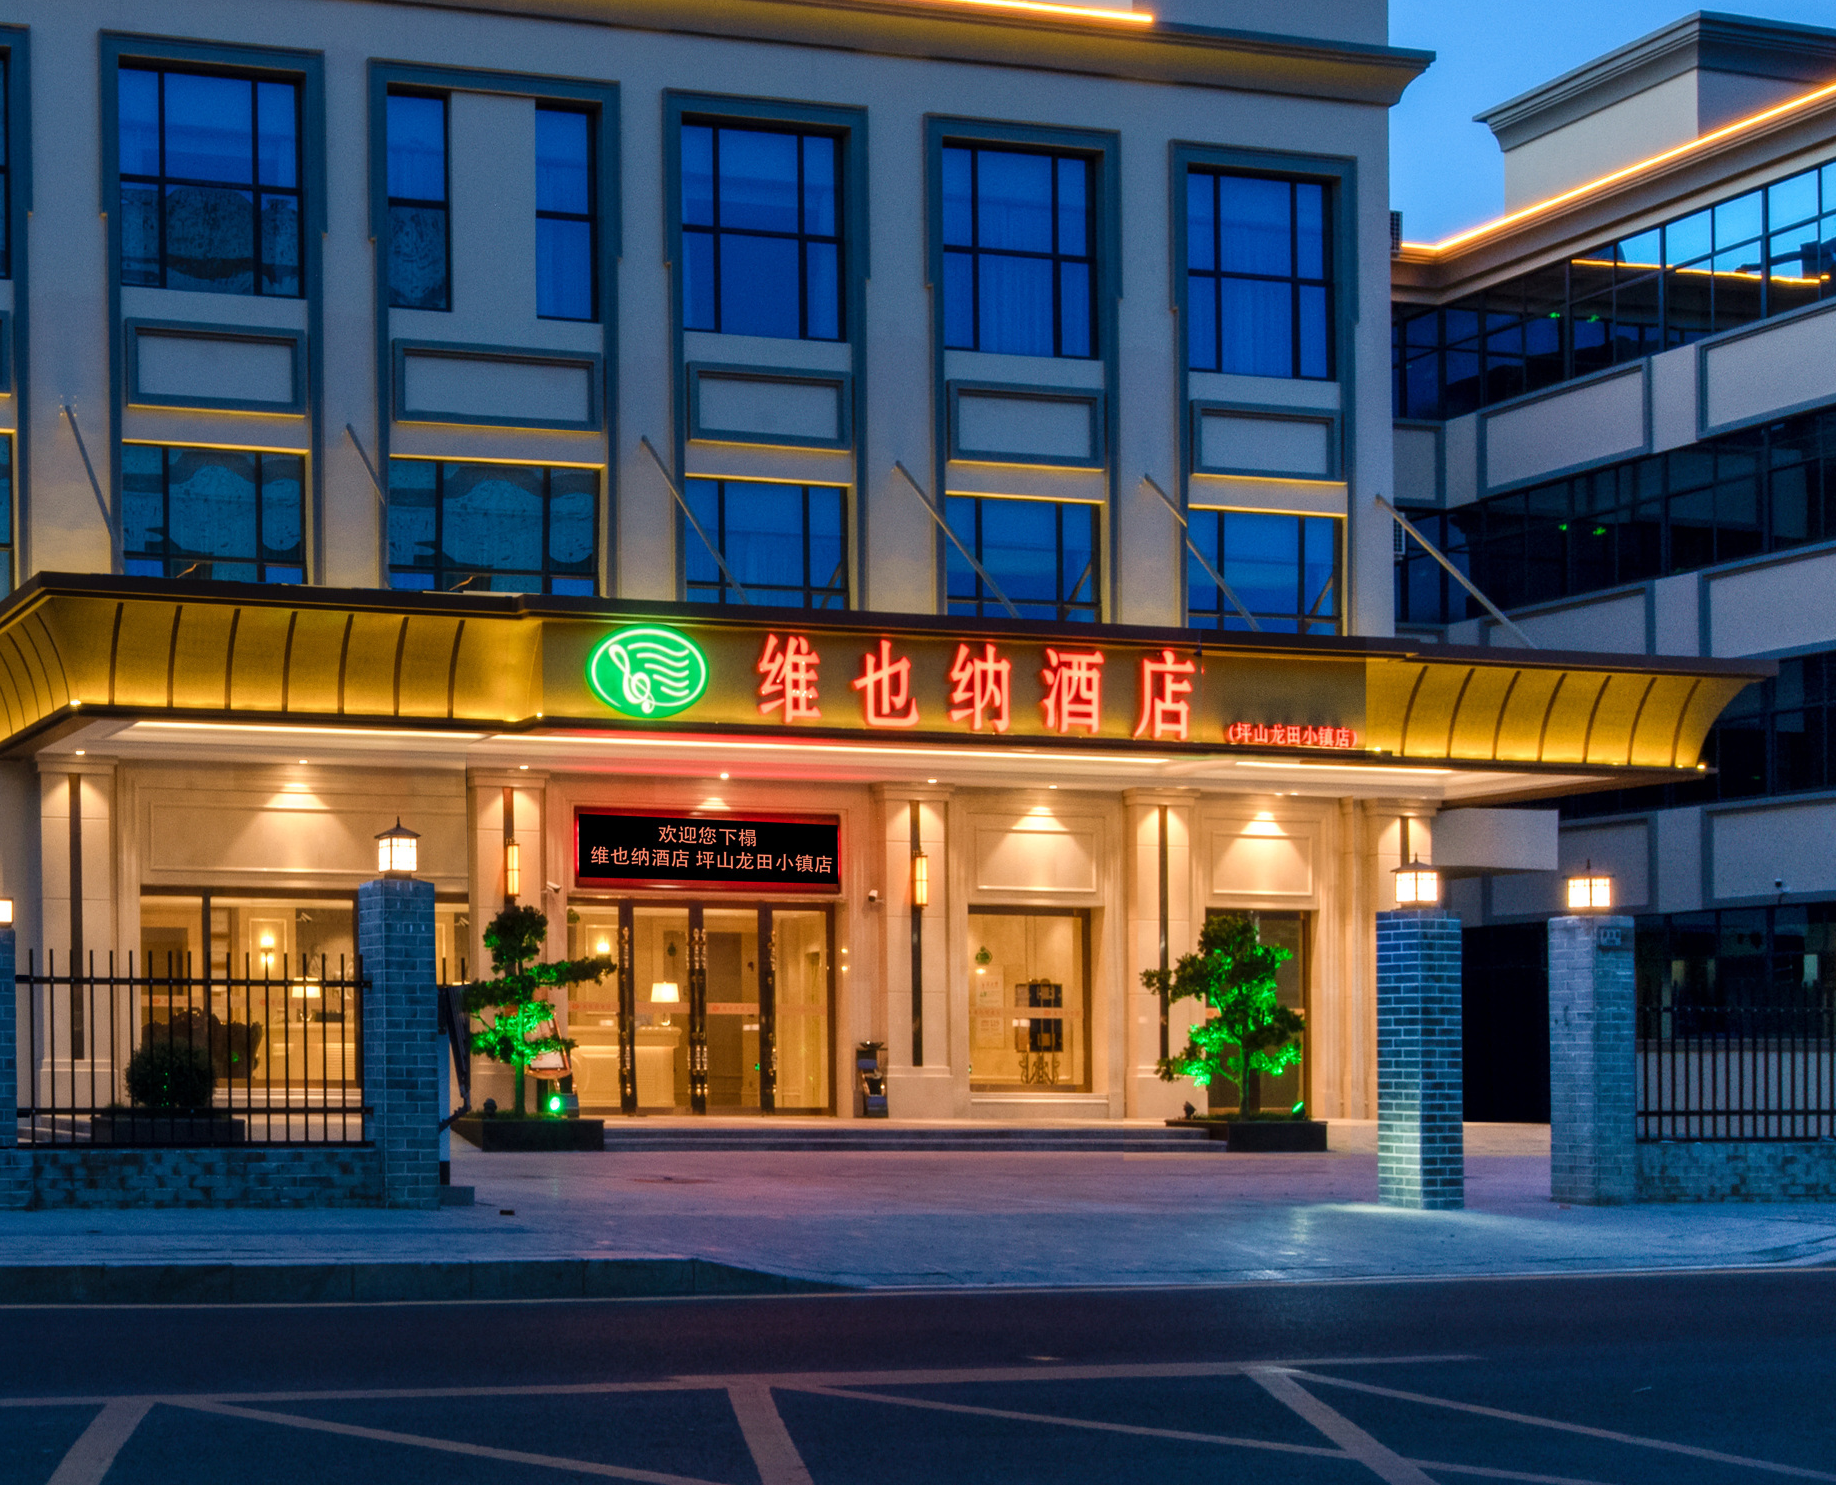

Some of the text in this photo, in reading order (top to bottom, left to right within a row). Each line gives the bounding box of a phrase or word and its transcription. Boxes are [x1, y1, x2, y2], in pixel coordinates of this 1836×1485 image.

[758, 633, 1196, 741] 维也纳酒店
[658, 824, 757, 847] 欢迎您下榻
[590, 846, 833, 874] 维也纳酒店 坪山龙田小镇店
